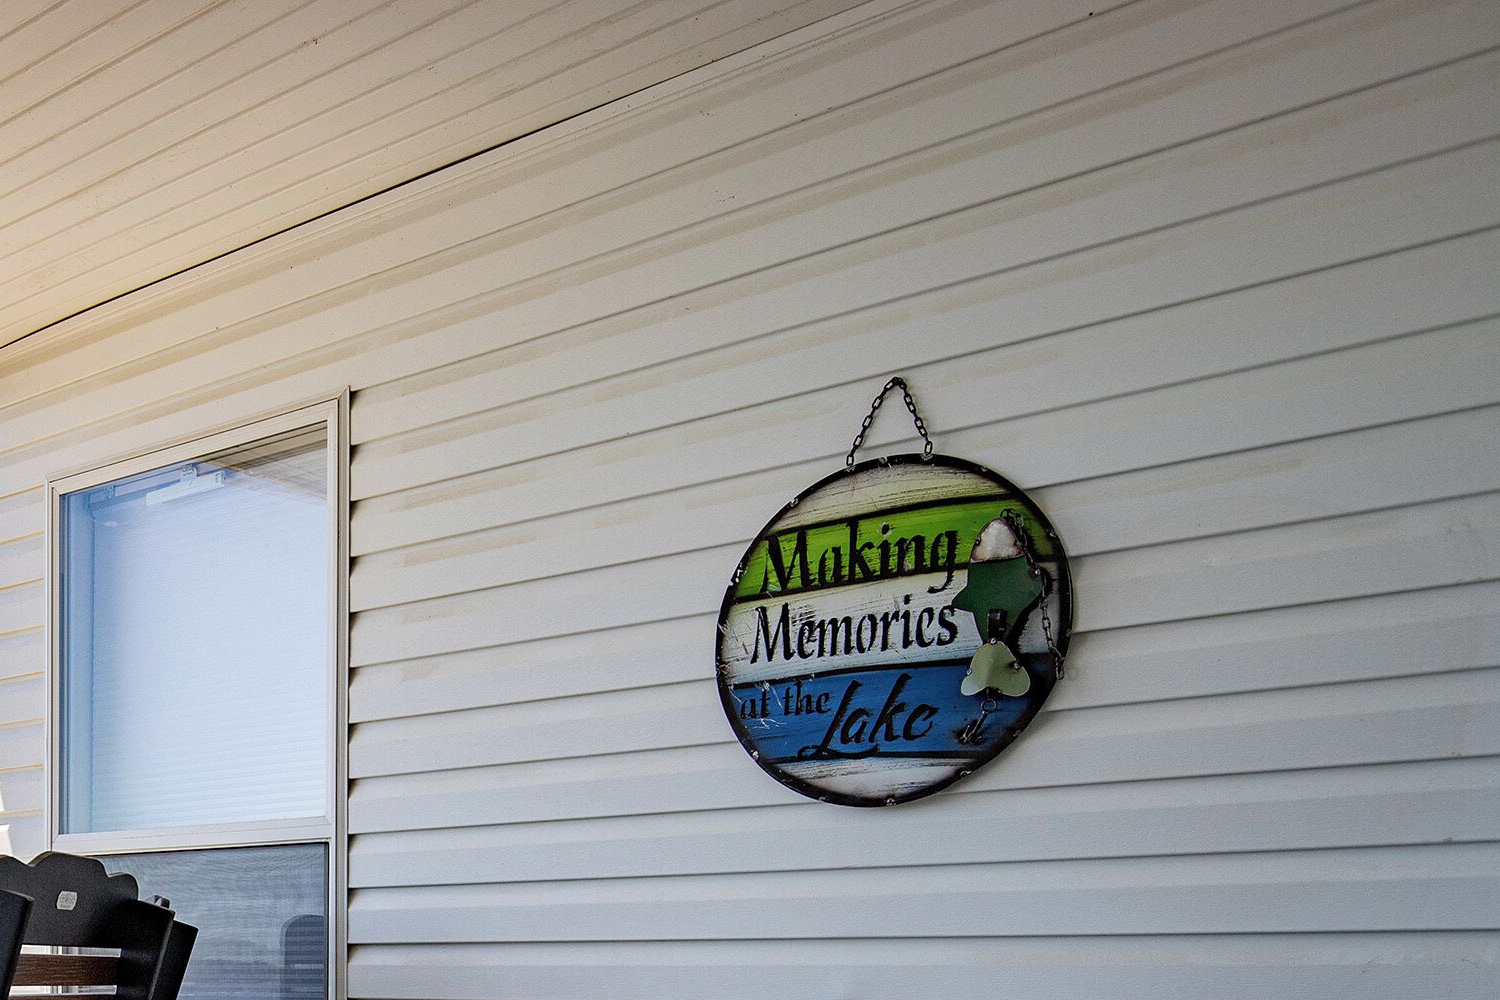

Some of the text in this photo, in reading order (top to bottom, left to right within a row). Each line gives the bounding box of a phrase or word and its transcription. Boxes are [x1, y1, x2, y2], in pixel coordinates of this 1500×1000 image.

[759, 520, 959, 594] Making
[749, 593, 960, 665] Memories
[740, 672, 940, 760] at the Lake
